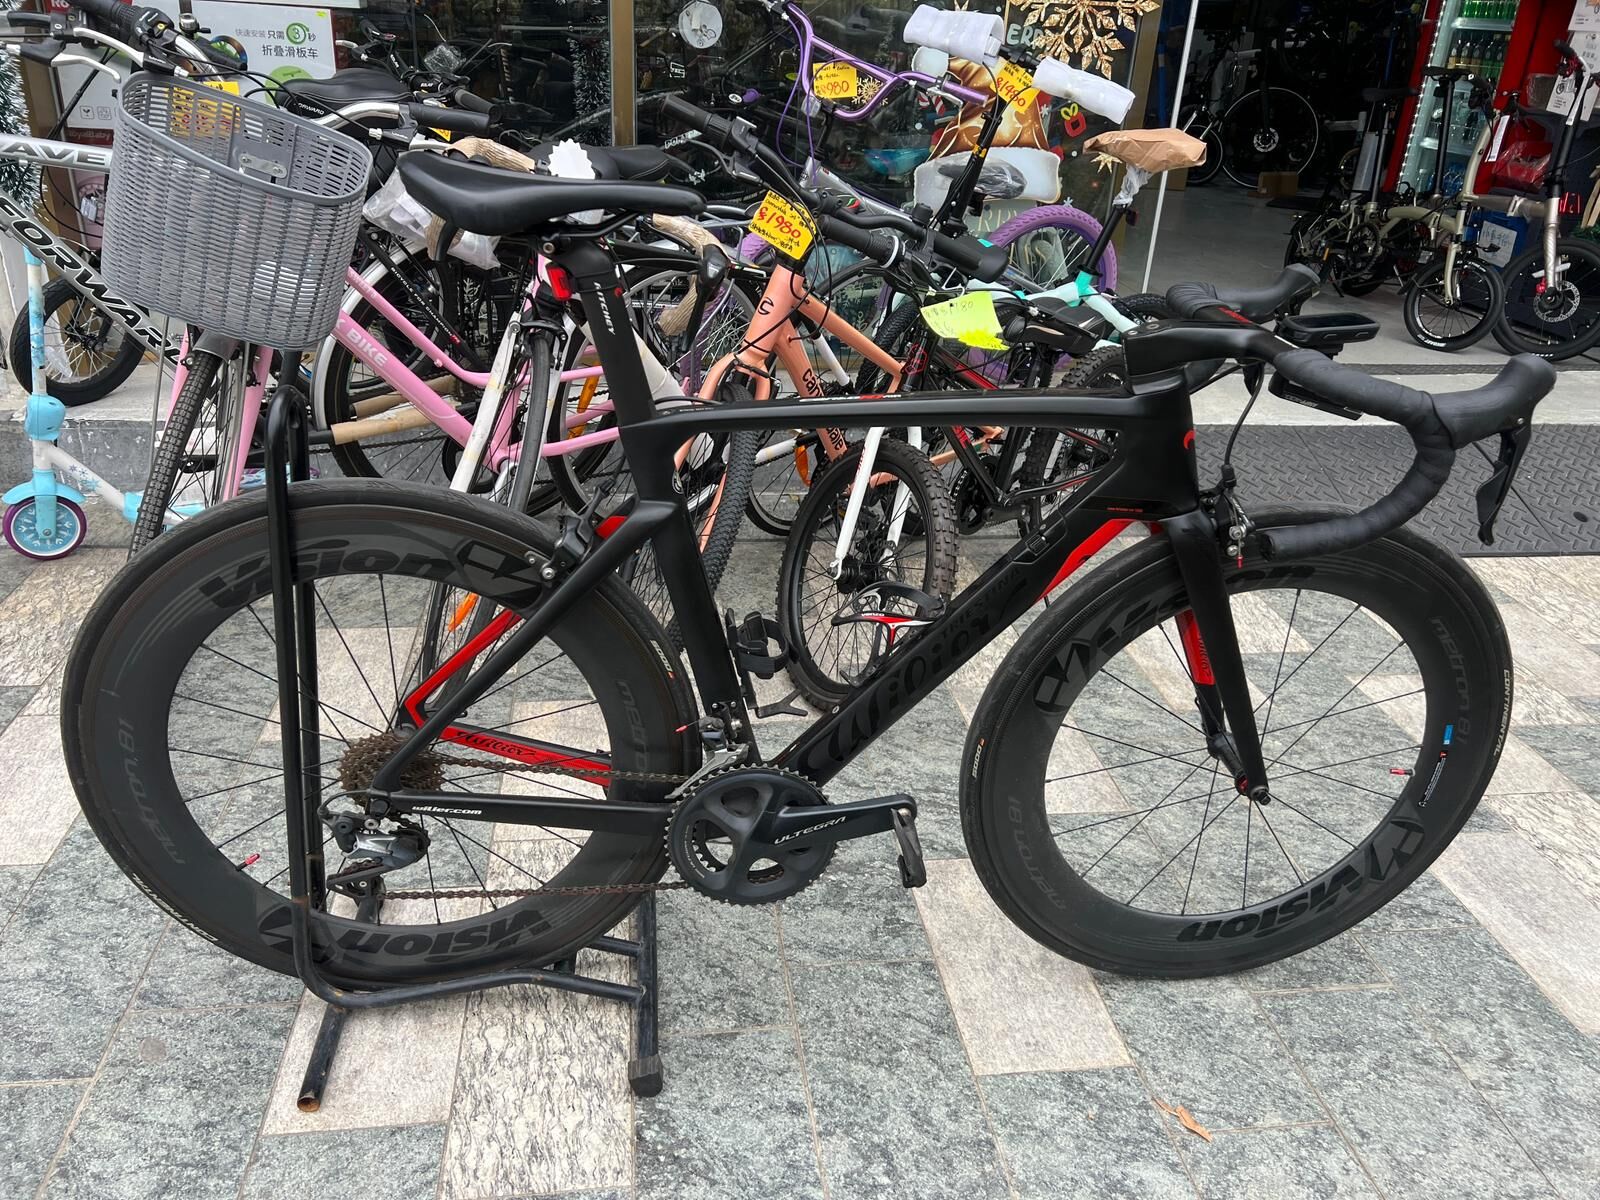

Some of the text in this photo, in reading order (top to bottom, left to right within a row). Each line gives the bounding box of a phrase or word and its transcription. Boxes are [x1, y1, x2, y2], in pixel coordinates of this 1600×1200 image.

[262, 44, 319, 60] 折叠滑板车
[346, 327, 388, 367] BIKE
[1493, 668, 1510, 757] CONTINENTAL
[411, 805, 482, 816] wilier.com
[774, 815, 846, 845] ULTEGRA
